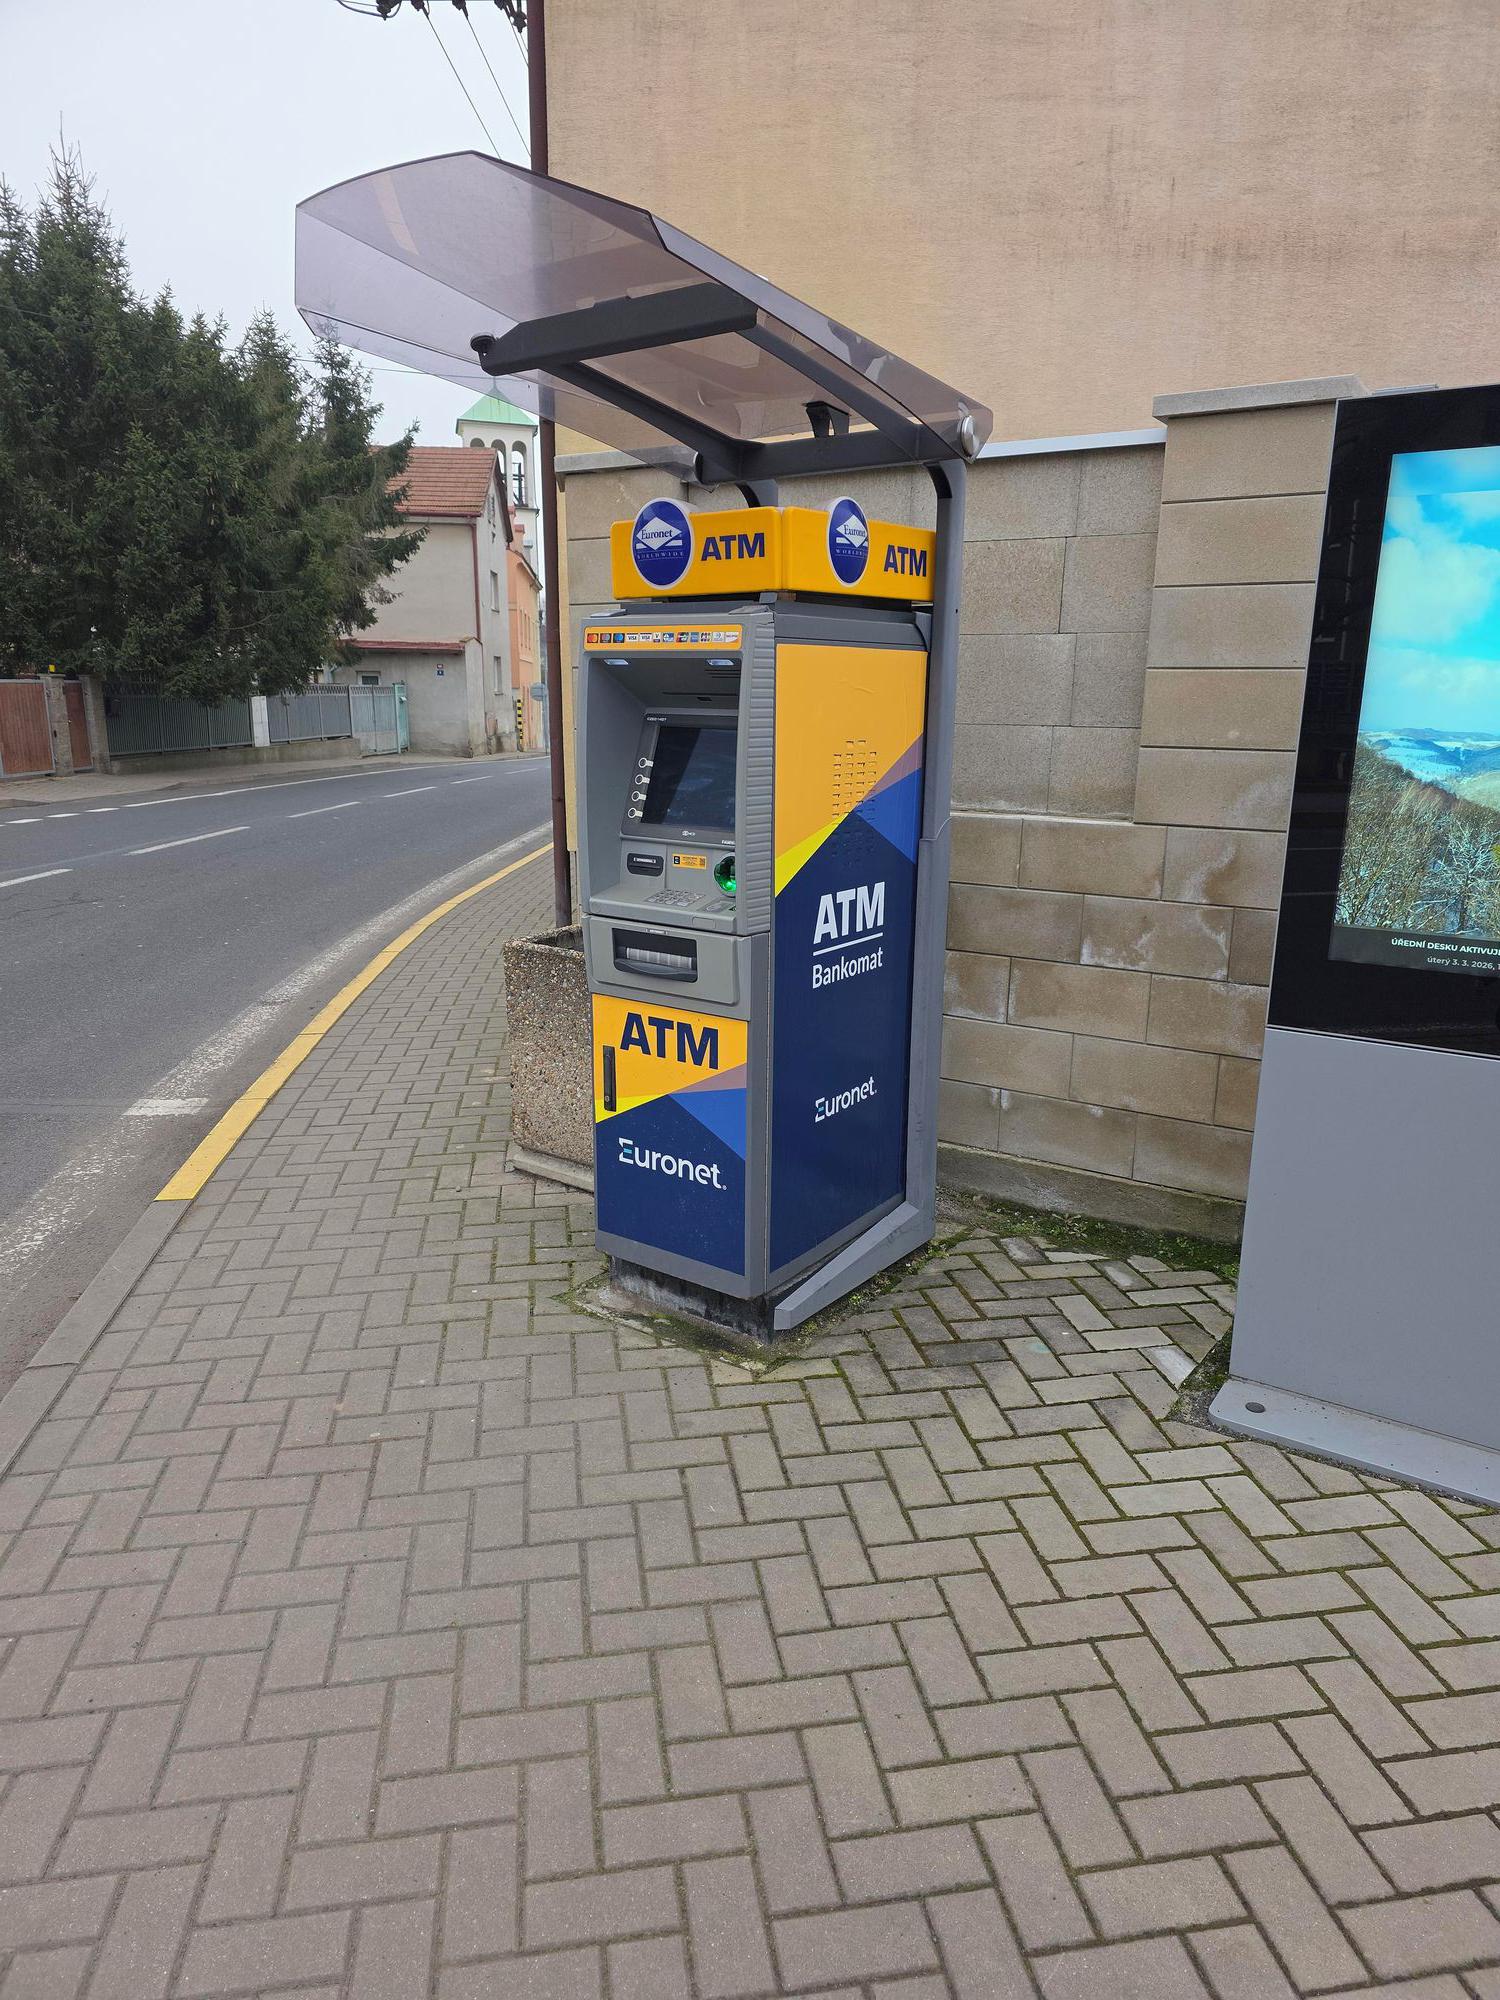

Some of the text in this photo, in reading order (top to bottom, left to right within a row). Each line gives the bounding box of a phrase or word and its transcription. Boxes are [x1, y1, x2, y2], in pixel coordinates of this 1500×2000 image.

[641, 529, 673, 540] Euronet
[701, 532, 765, 562] ATM
[883, 544, 927, 578] ATM
[813, 881, 885, 945] ATM
[1391, 937, 1426, 949] ÚŘEDNÍ
[1427, 942, 1458, 951] DESKU
[812, 946, 884, 989] Bankomat
[1427, 956, 1451, 966] úterý
[1452, 958, 1460, 966] 3.
[1461, 959, 1469, 967] 3.
[1471, 961, 1495, 971] 2026,
[620, 1011, 719, 1070] ATM
